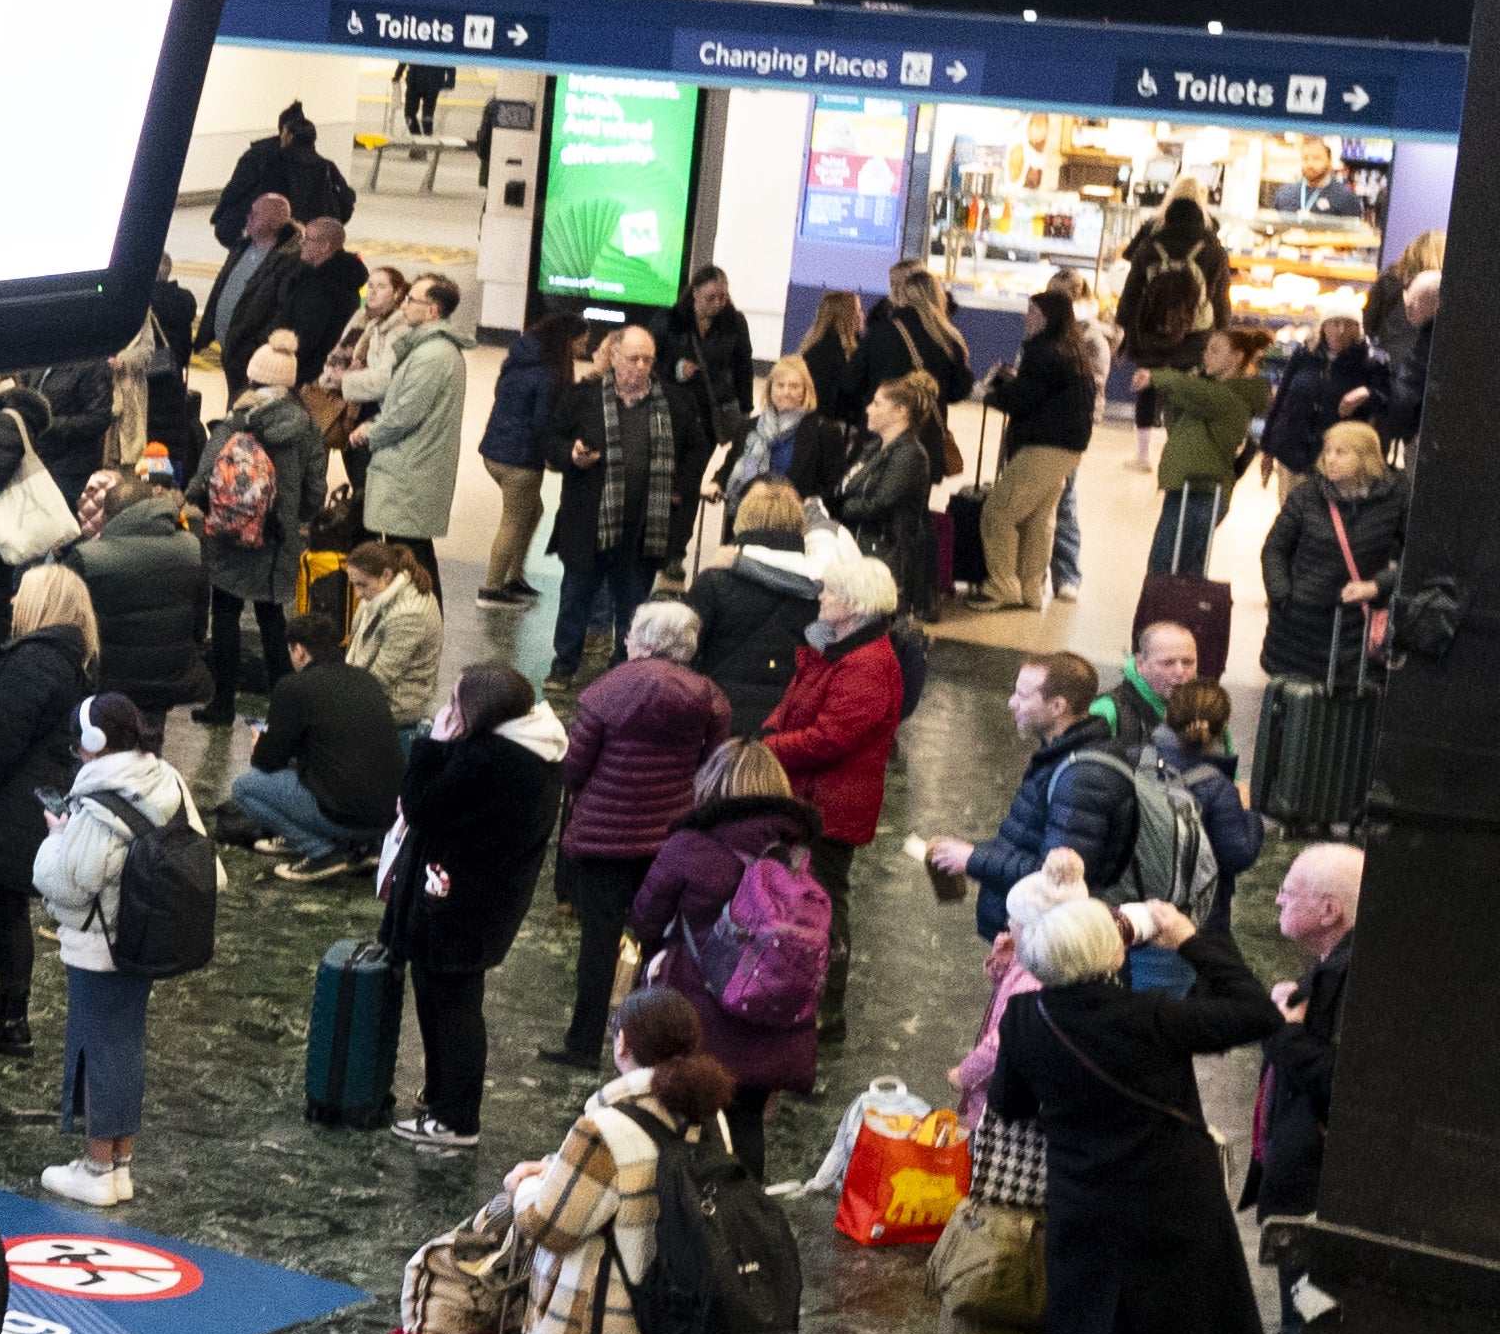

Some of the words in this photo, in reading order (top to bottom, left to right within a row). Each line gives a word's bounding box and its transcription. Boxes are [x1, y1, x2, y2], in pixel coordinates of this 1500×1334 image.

[375, 13, 455, 43] Toilets
[699, 40, 808, 76] Changing
[813, 50, 889, 80] Places
[1174, 70, 1275, 110] Toilets
